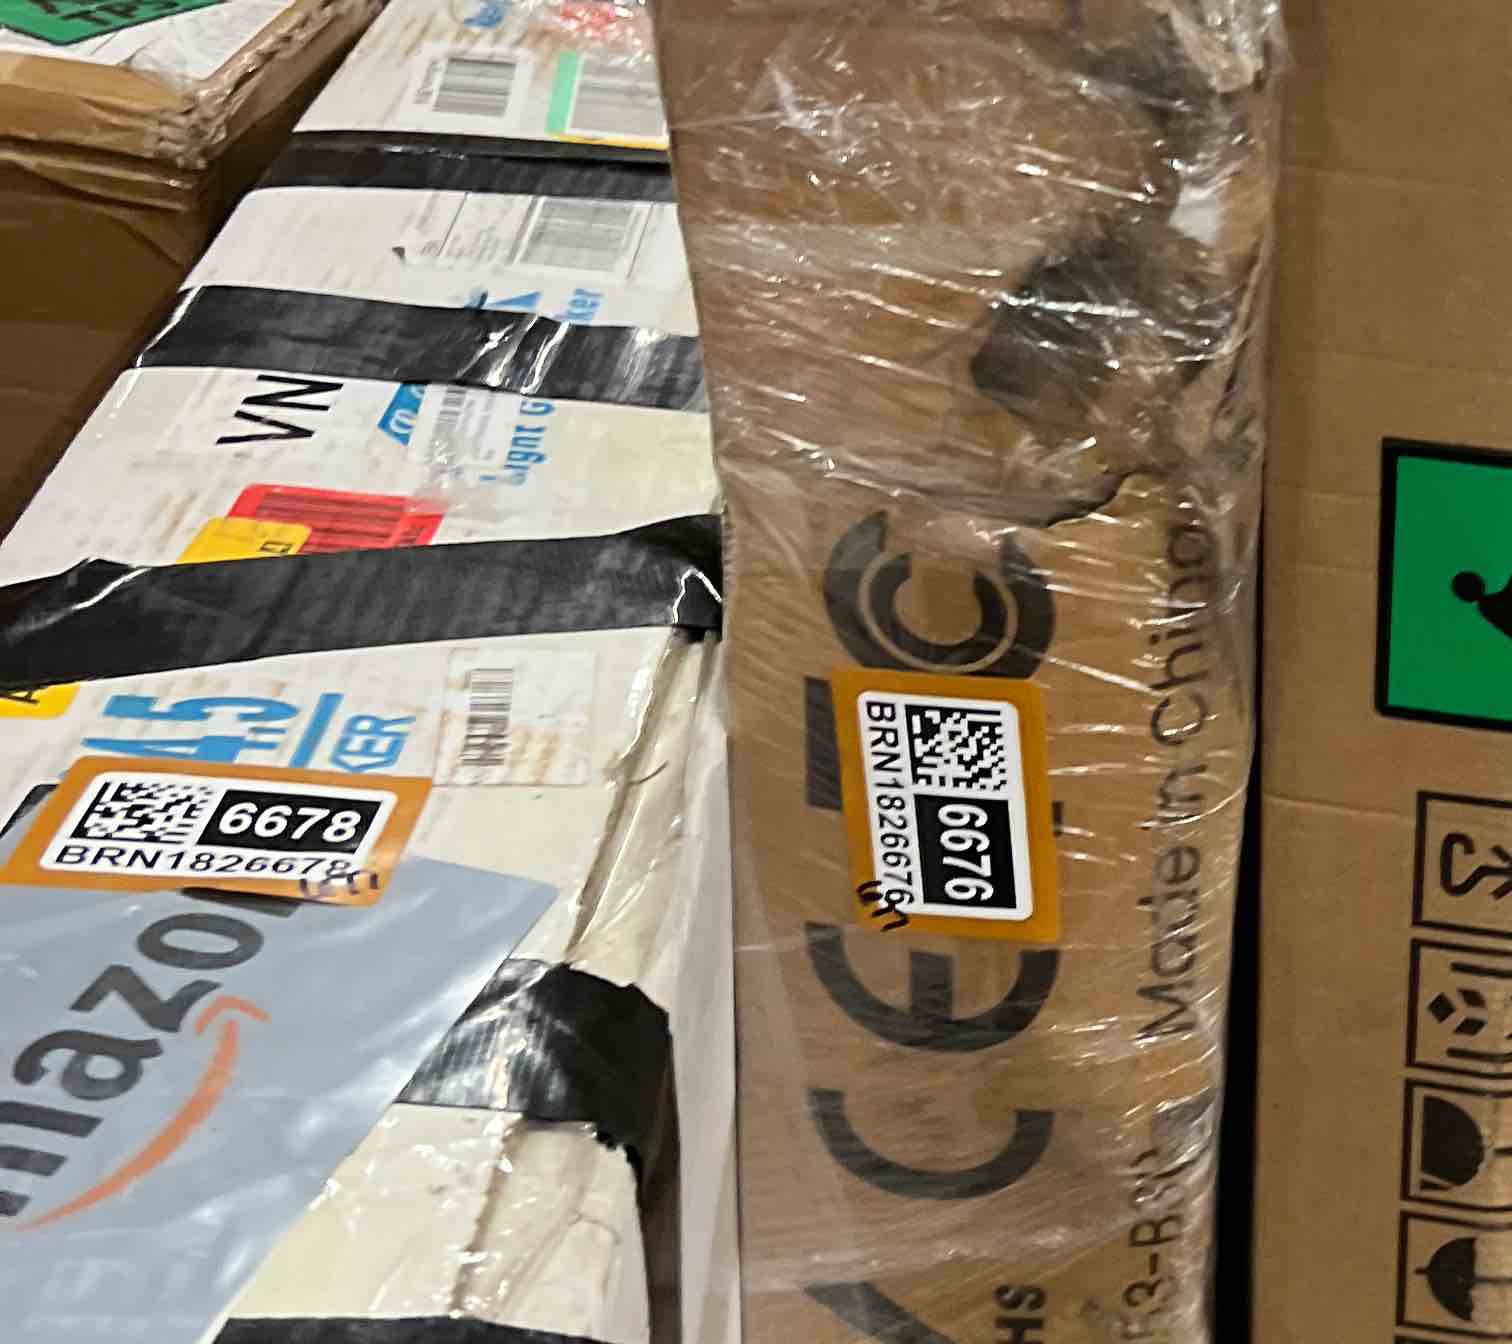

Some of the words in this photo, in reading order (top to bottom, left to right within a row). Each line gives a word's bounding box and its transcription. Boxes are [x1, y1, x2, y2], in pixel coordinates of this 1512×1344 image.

[216, 374, 343, 446] VN
[1148, 525, 1216, 747] China
[217, 801, 362, 844] 6678
[866, 699, 916, 908] BRN1826676
[1139, 762, 1207, 831] in
[55, 842, 356, 879] BRN1826678
[939, 801, 995, 903] 6676
[1136, 845, 1202, 1043] Made
